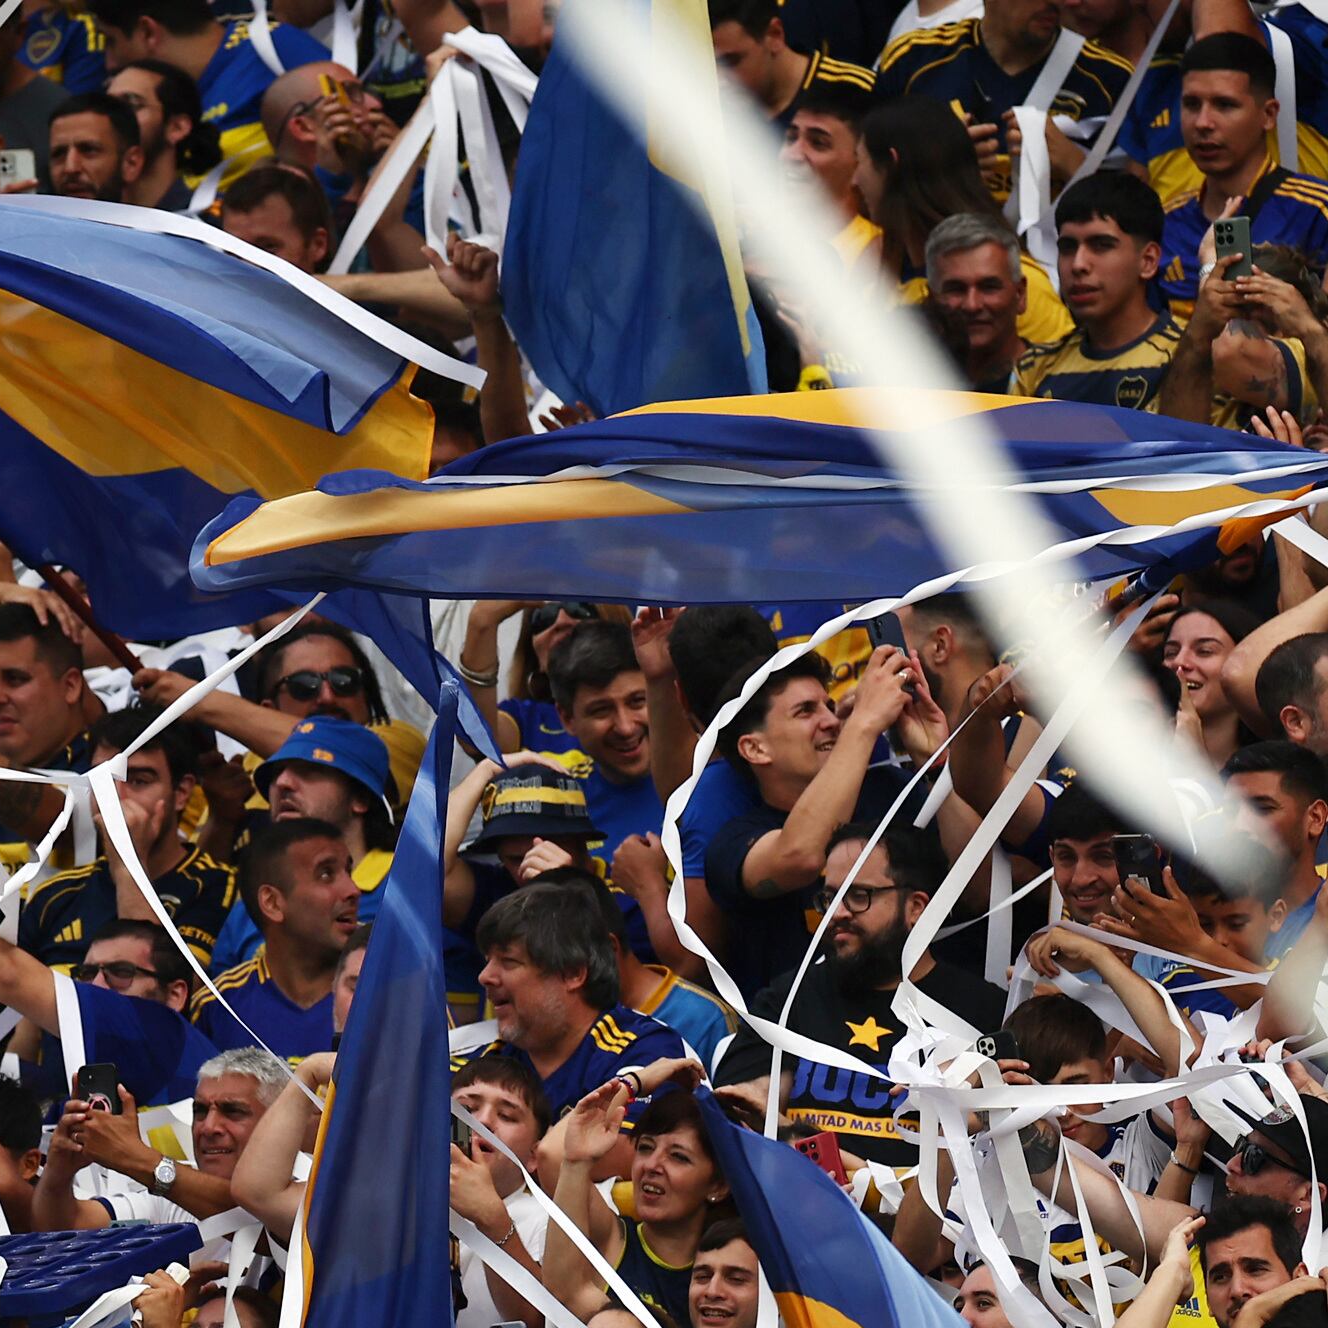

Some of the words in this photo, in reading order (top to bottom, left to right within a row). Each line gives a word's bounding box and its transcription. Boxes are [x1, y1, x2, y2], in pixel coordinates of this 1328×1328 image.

[808, 1114, 846, 1130] MITAD
[848, 1118, 882, 1133] MAS
[1175, 1308, 1202, 1319] adidas
